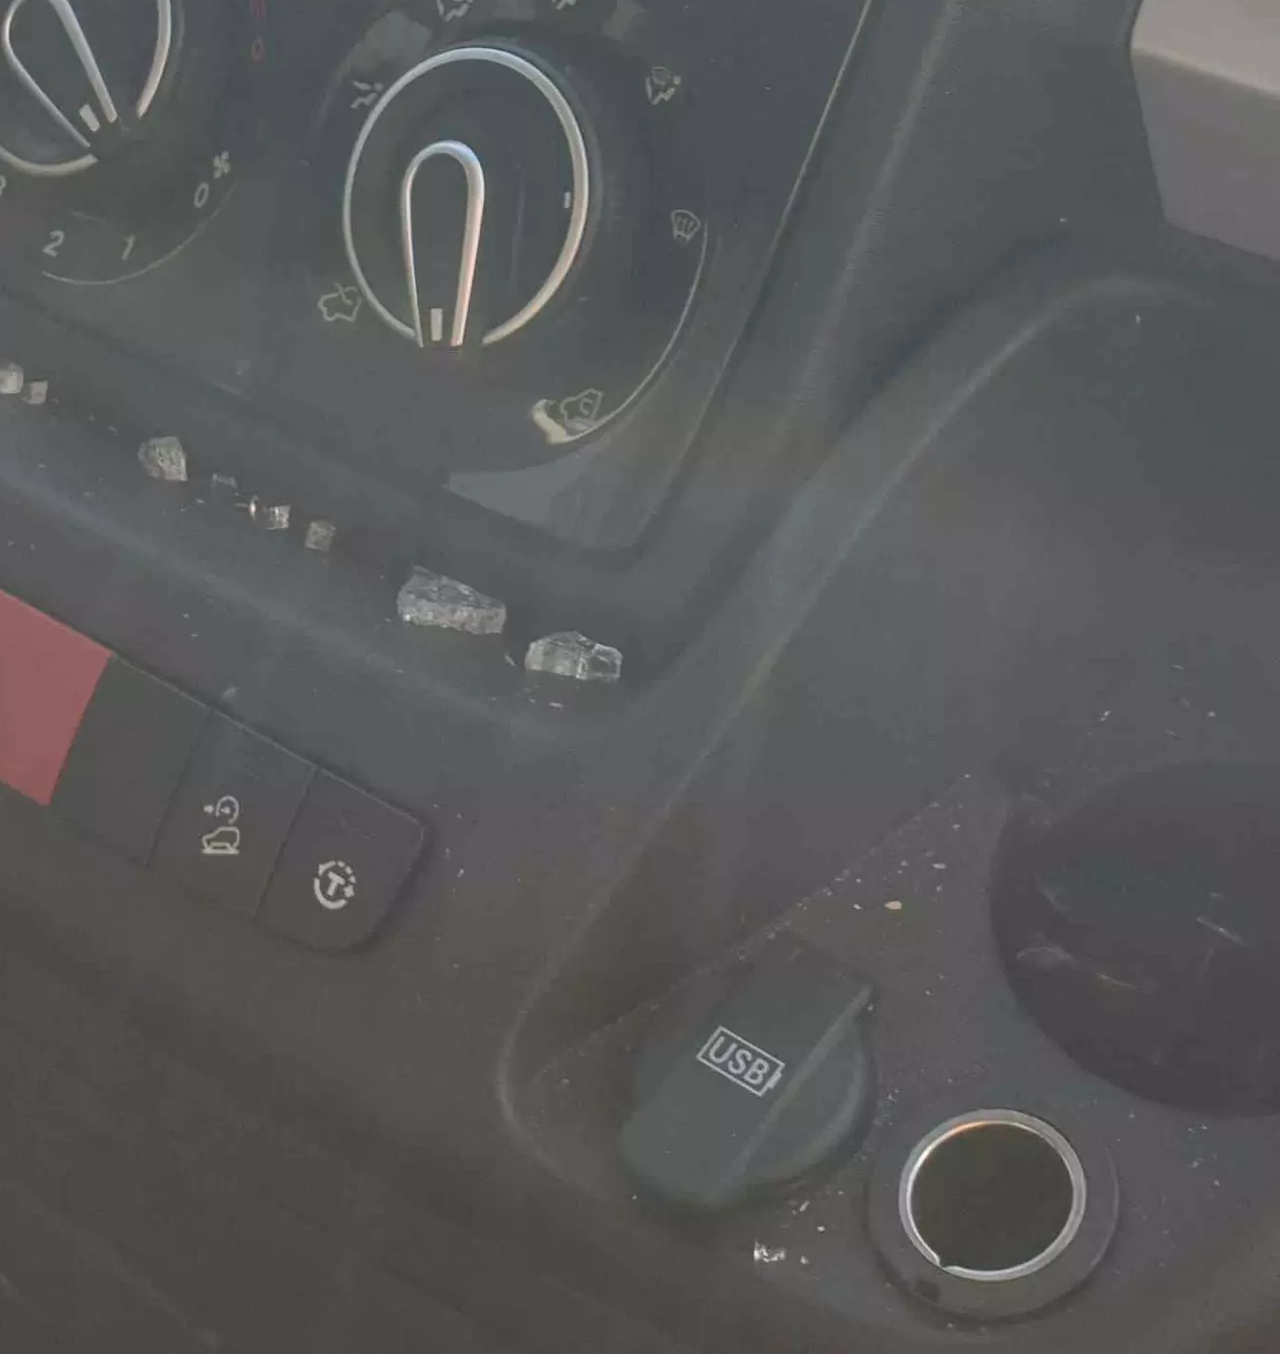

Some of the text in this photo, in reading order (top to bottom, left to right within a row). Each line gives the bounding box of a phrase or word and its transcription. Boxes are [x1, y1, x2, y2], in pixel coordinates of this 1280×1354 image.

[192, 180, 211, 209] 0
[41, 229, 66, 258] 2
[120, 233, 137, 261] 1
[706, 1033, 773, 1087] USB
